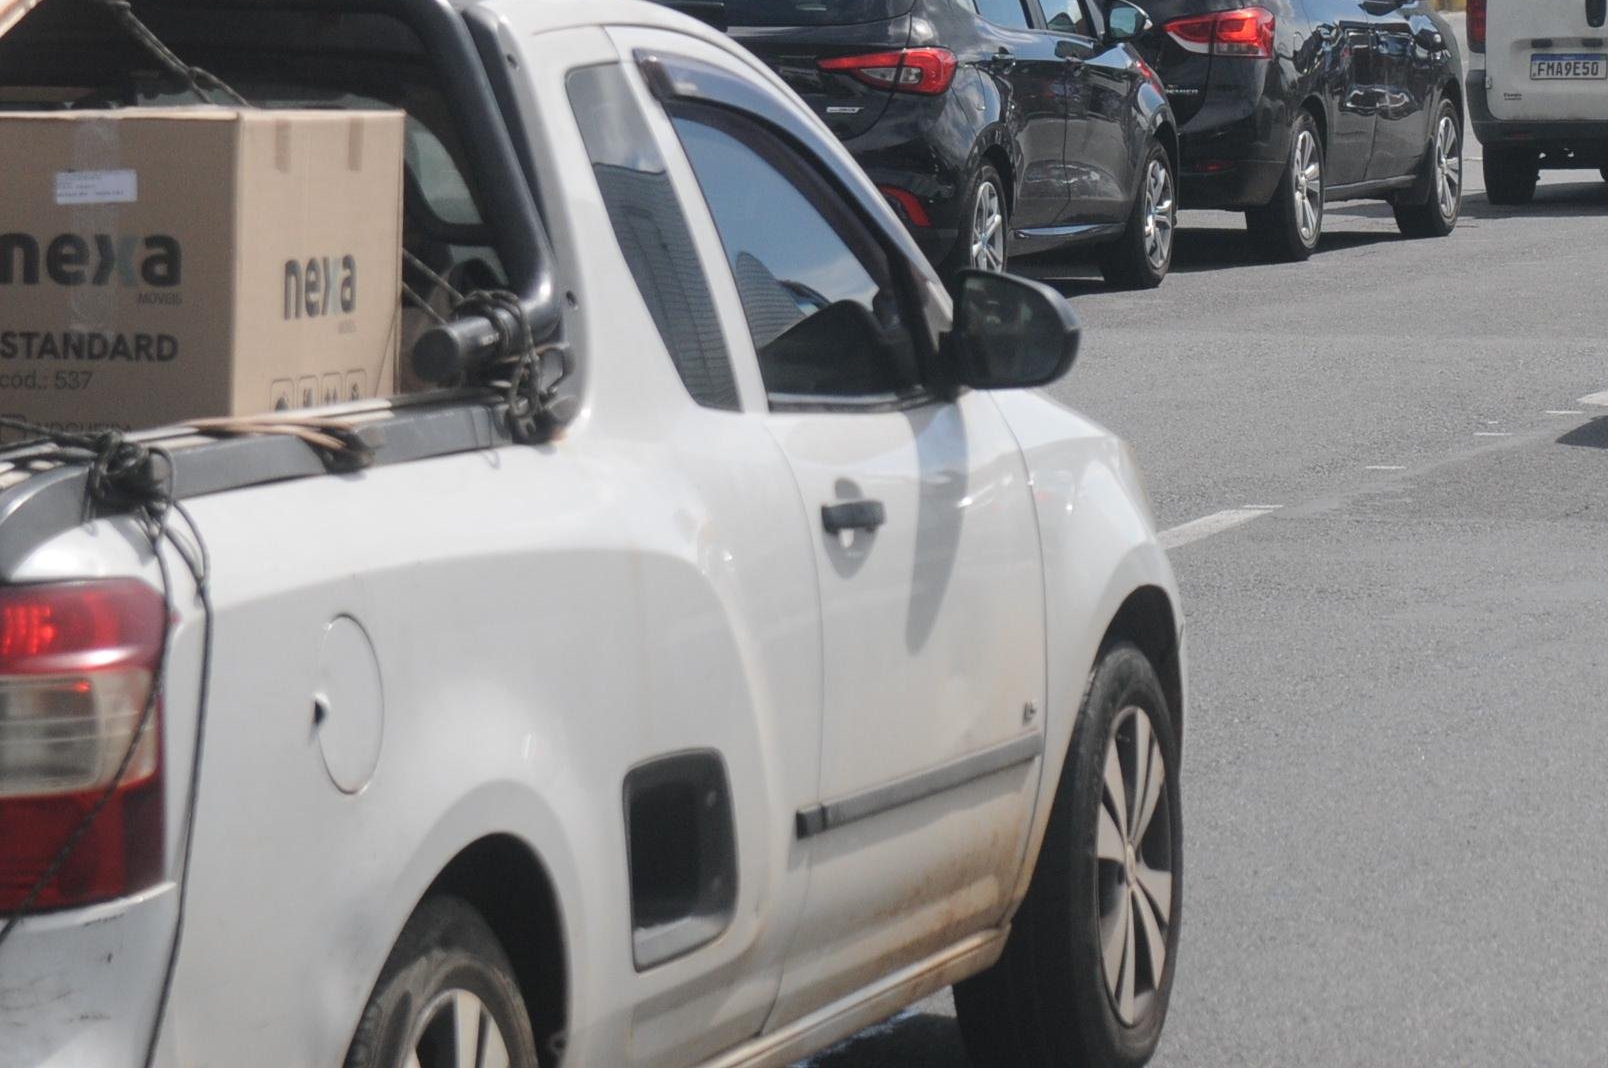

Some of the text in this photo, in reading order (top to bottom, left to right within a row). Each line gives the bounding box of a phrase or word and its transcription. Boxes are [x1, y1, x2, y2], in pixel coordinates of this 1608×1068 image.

[1537, 62, 1599, 76] FMA9E50
[0, 232, 183, 287] nexa
[284, 254, 357, 321] nexa
[0, 331, 179, 363] STANDARD
[55, 371, 93, 390] 537
